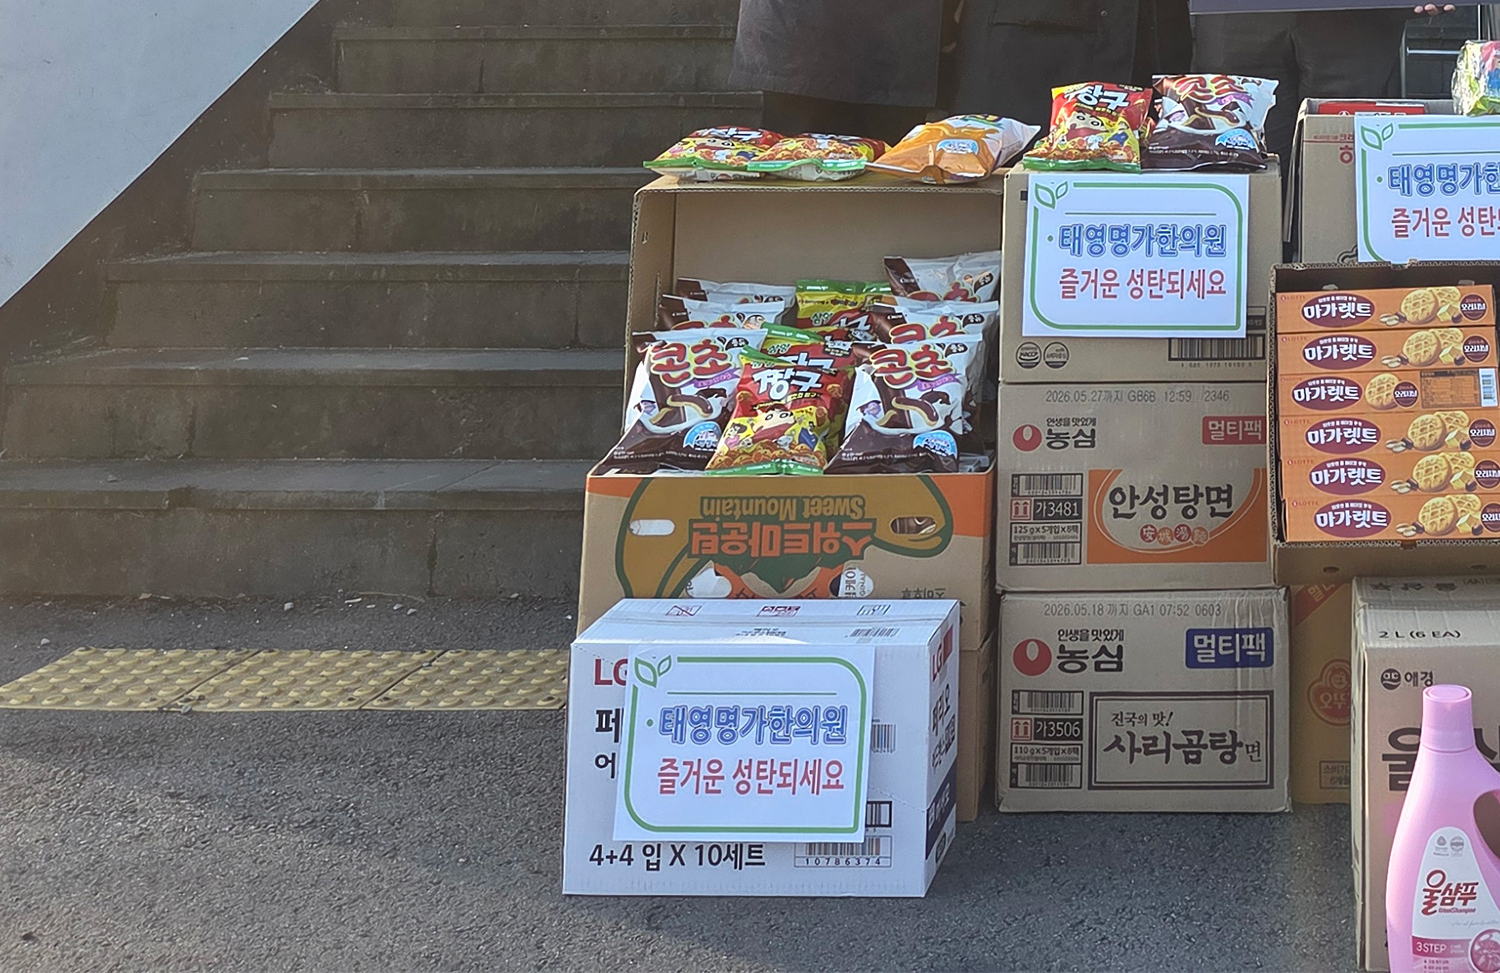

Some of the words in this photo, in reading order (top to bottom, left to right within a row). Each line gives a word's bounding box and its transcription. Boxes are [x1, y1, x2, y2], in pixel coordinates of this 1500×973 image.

[1391, 206, 1451, 238] 즐거운
[1058, 224, 1227, 258] 태영명가한의원
[1059, 268, 1120, 299] 즐거운
[1126, 268, 1226, 300] 성탄되세요
[1303, 302, 1372, 319] 마가렛트
[651, 338, 732, 384] 콘초
[870, 344, 952, 385] 콘초
[1304, 344, 1373, 361] 마가렛트
[752, 368, 822, 400] 짱구
[1164, 390, 1192, 402] 12:59
[1293, 386, 1362, 402] 마가렛트
[1046, 428, 1096, 450] 농심
[1208, 420, 1262, 441] 멀티팩
[1308, 427, 1377, 445] 마가렛트
[1312, 468, 1382, 485] 마가렛트
[702, 496, 797, 520] Mountain
[804, 496, 866, 520] Sweet
[1036, 501, 1079, 518] 가3481
[1109, 484, 1233, 520] 안성탕면
[1316, 510, 1388, 528] 마가렛트
[692, 521, 874, 557] 스위트마운틴
[1044, 604, 1104, 616] 2026.05.18
[1107, 604, 1129, 616] 까지
[1159, 604, 1190, 616] 07:52
[1195, 604, 1222, 616] 0603
[1058, 629, 1090, 642] 인생을
[1091, 629, 1124, 642] 맛있게
[1194, 632, 1266, 663] 멀티팩
[1056, 644, 1124, 673] 농심
[1404, 670, 1434, 687] 애경
[658, 704, 848, 745] 태영명가한의원
[1036, 721, 1080, 738] 가3506
[1111, 712, 1148, 726] 진국의
[1152, 711, 1175, 727] 맛!
[1103, 729, 1262, 765] 사리곰탕면
[657, 757, 725, 795] 즐거운
[732, 757, 845, 796] 성탄되세요
[589, 844, 634, 866] 4+4
[642, 844, 661, 871] 입
[669, 844, 686, 866] X
[695, 843, 766, 870] 10세트
[805, 857, 882, 866] 10786374
[1421, 869, 1479, 916] 울샴푸
